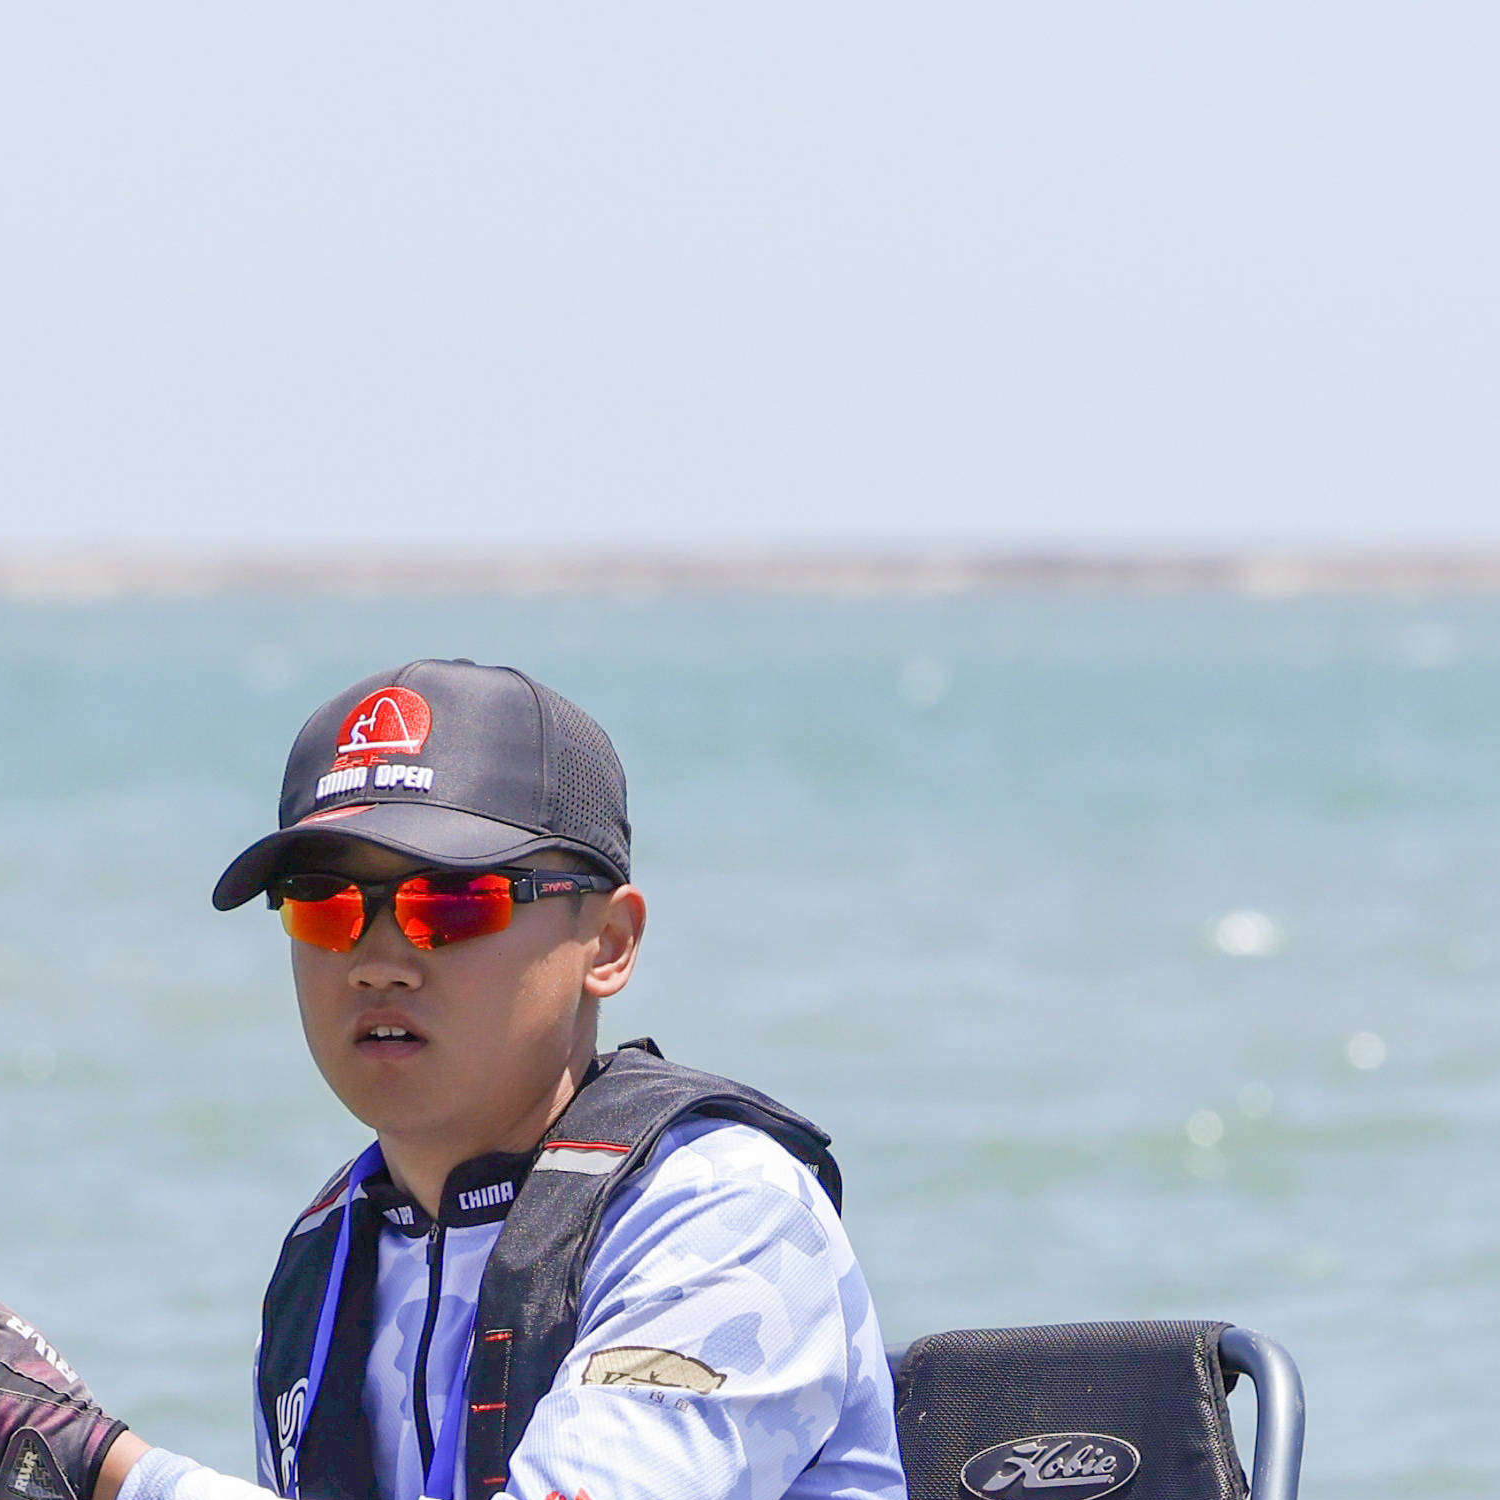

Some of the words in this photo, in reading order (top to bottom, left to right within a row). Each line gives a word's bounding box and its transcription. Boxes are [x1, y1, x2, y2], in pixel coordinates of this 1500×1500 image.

[374, 765, 434, 791] OPEN
[458, 1180, 515, 1210] CHINA
[982, 1439, 1117, 1492] Hobie
